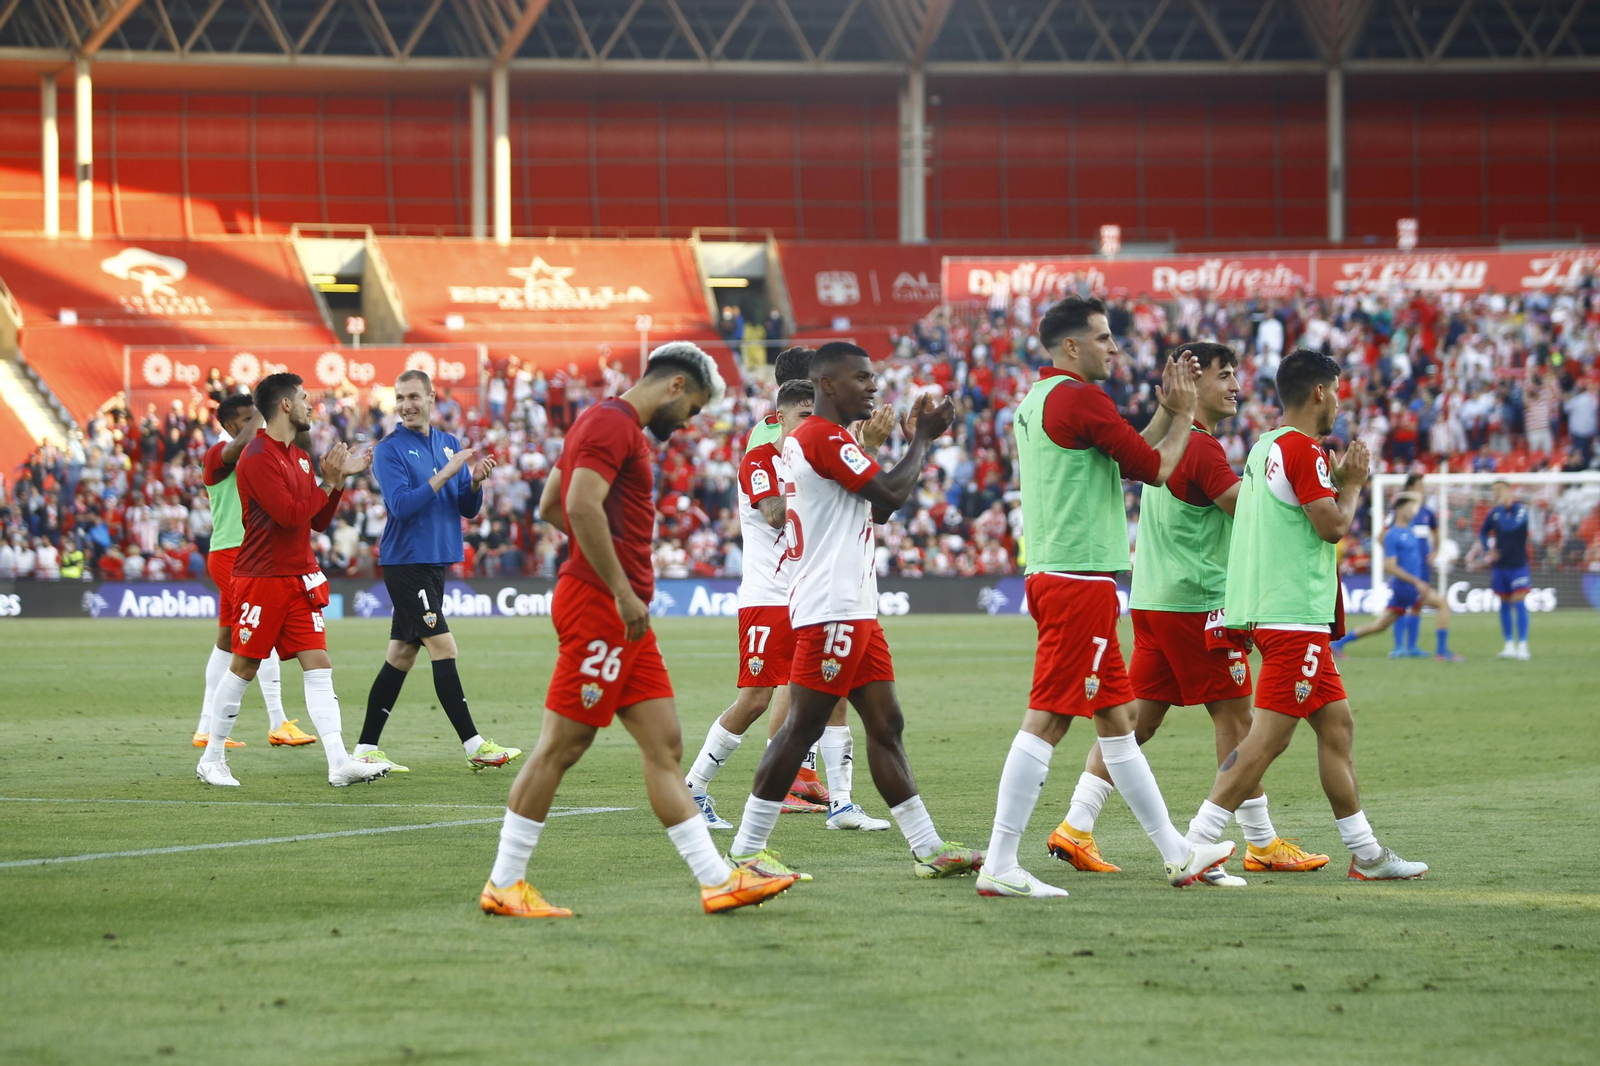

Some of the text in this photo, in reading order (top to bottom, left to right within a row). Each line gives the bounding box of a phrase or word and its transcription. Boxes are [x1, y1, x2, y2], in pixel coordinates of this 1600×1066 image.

[174, 361, 200, 384] bp
[349, 359, 376, 384] bp
[438, 358, 466, 384] bp
[119, 589, 216, 617] Arabian
[418, 589, 430, 610] 1
[239, 602, 262, 628] 24
[747, 626, 771, 653] 17
[823, 623, 854, 657] 15
[580, 639, 623, 682] 26
[1092, 636, 1108, 671] 7
[1301, 643, 1322, 677] 5
